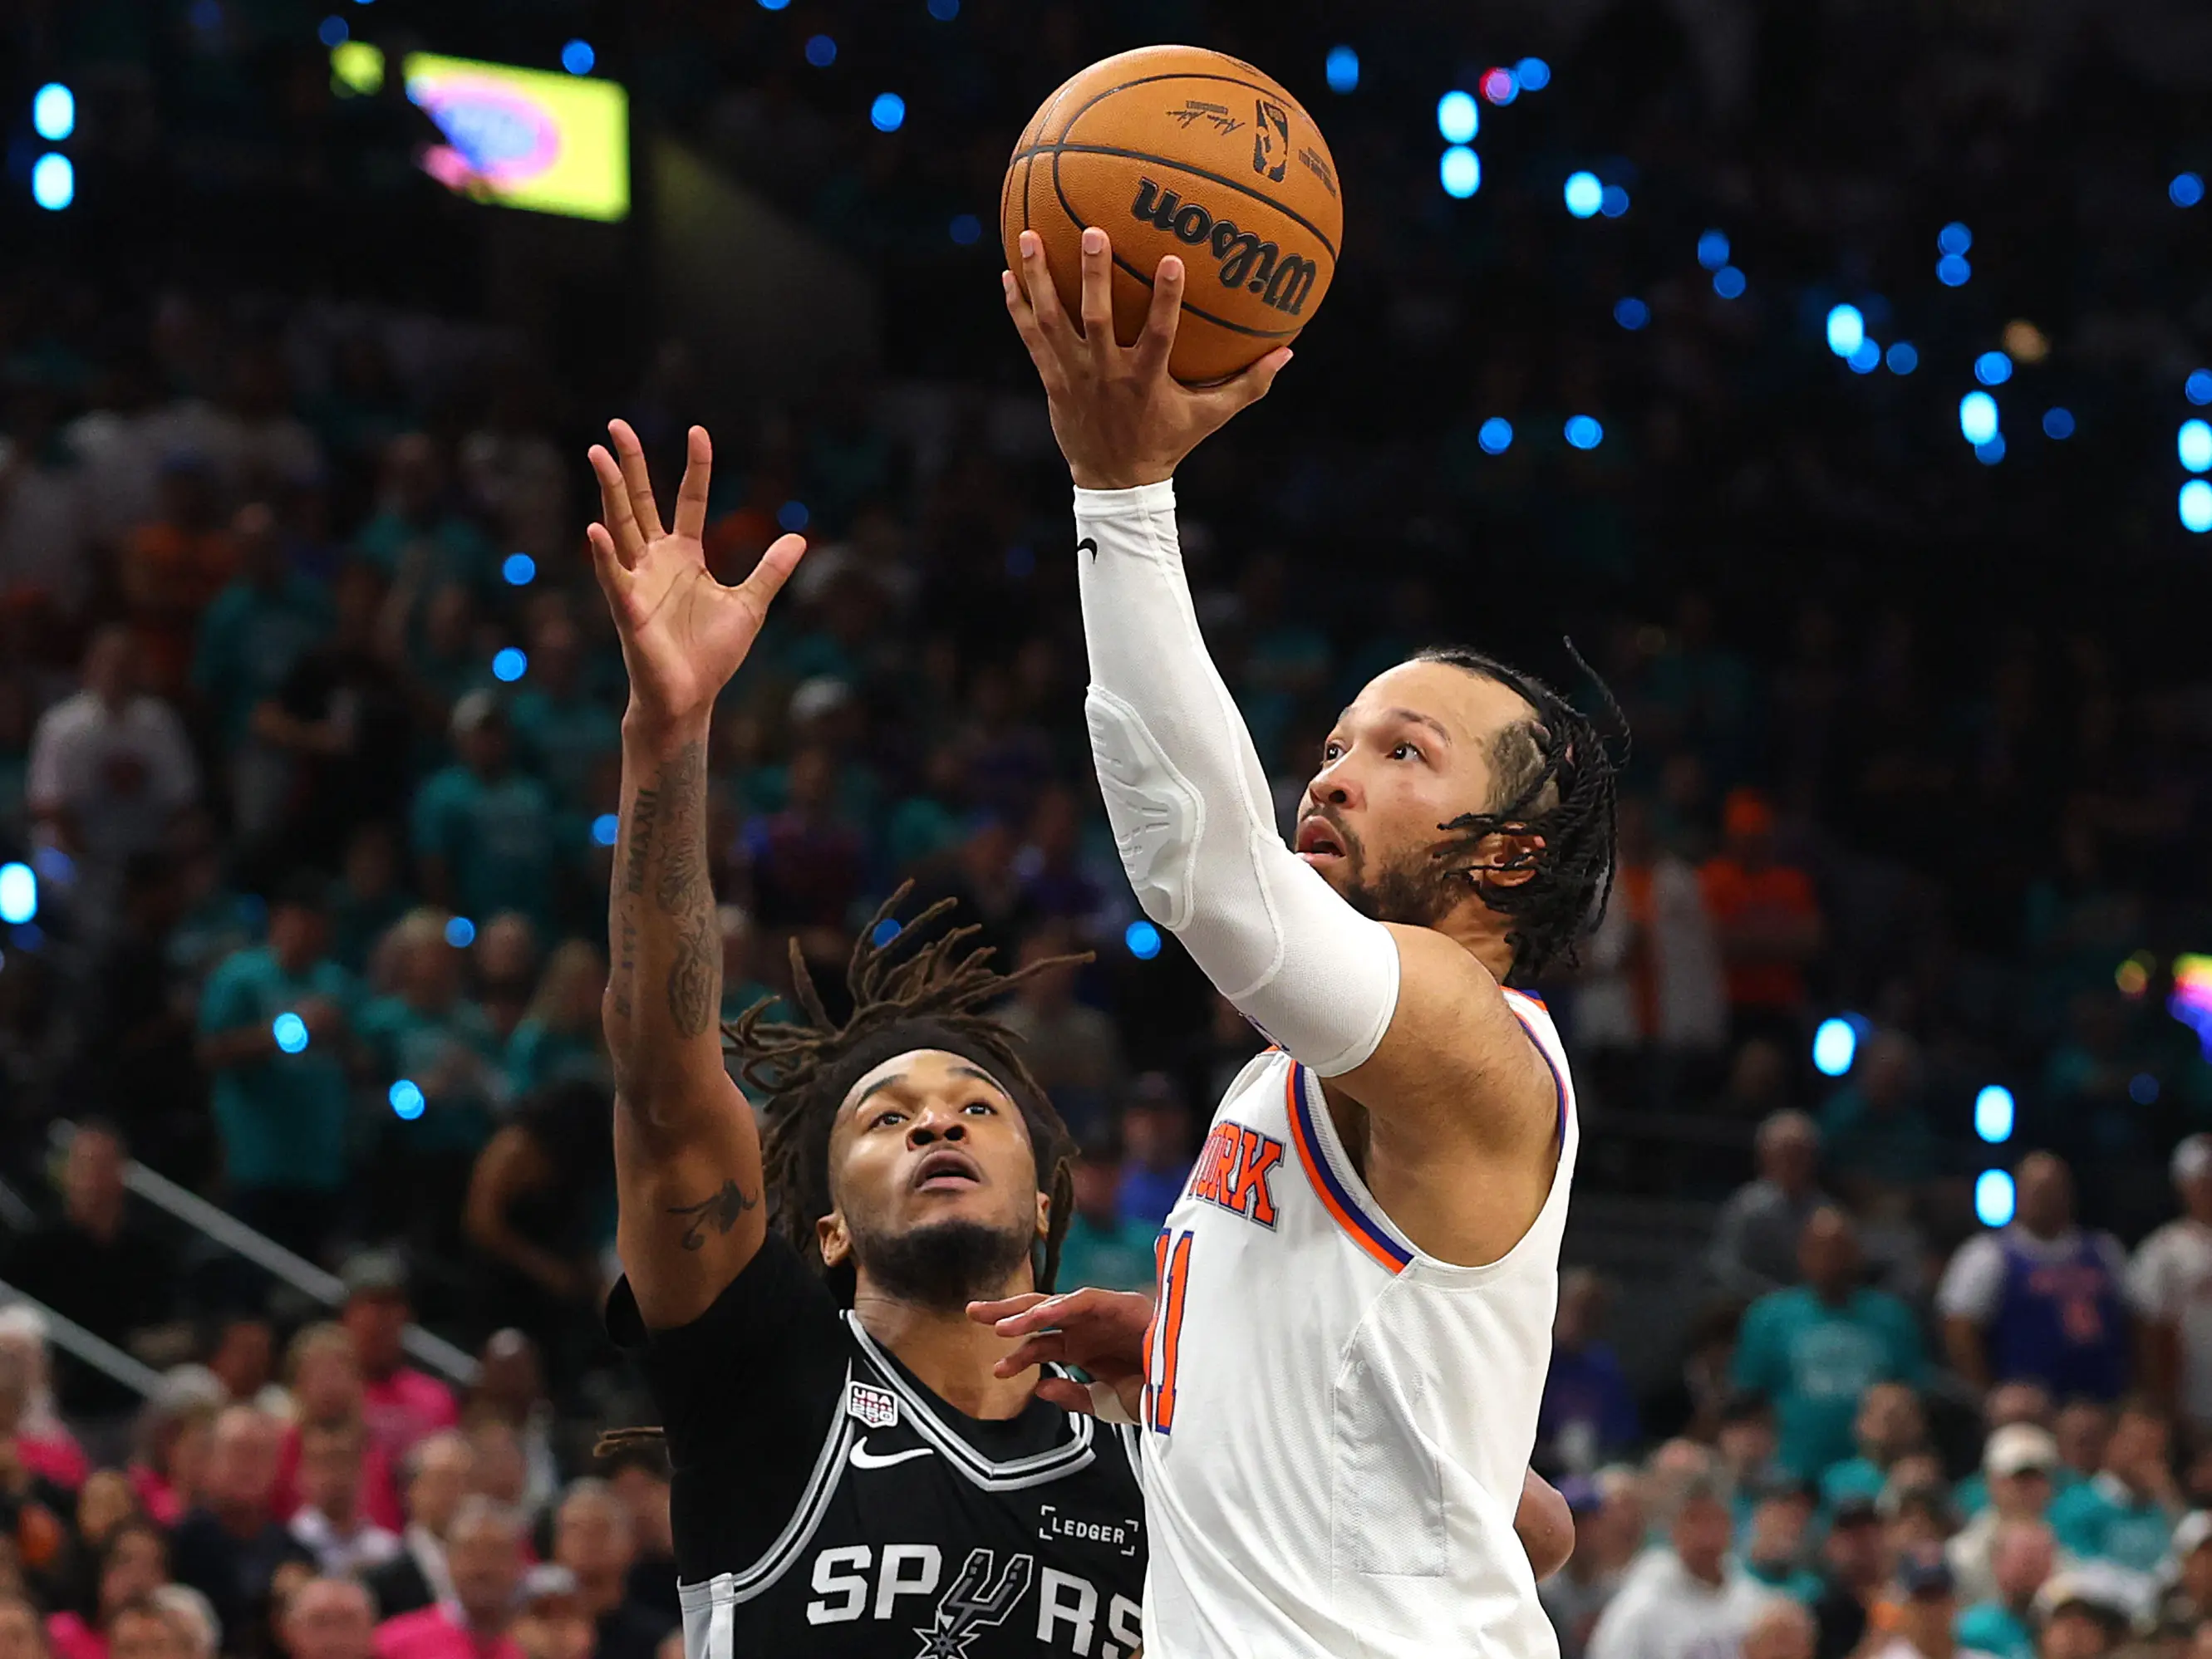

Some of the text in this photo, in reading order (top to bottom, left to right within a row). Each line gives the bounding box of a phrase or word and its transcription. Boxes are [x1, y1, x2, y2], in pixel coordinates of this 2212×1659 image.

[1131, 176, 1316, 316] Wilson
[853, 1387, 892, 1406] USA
[1052, 1517, 1125, 1544] LEDGER
